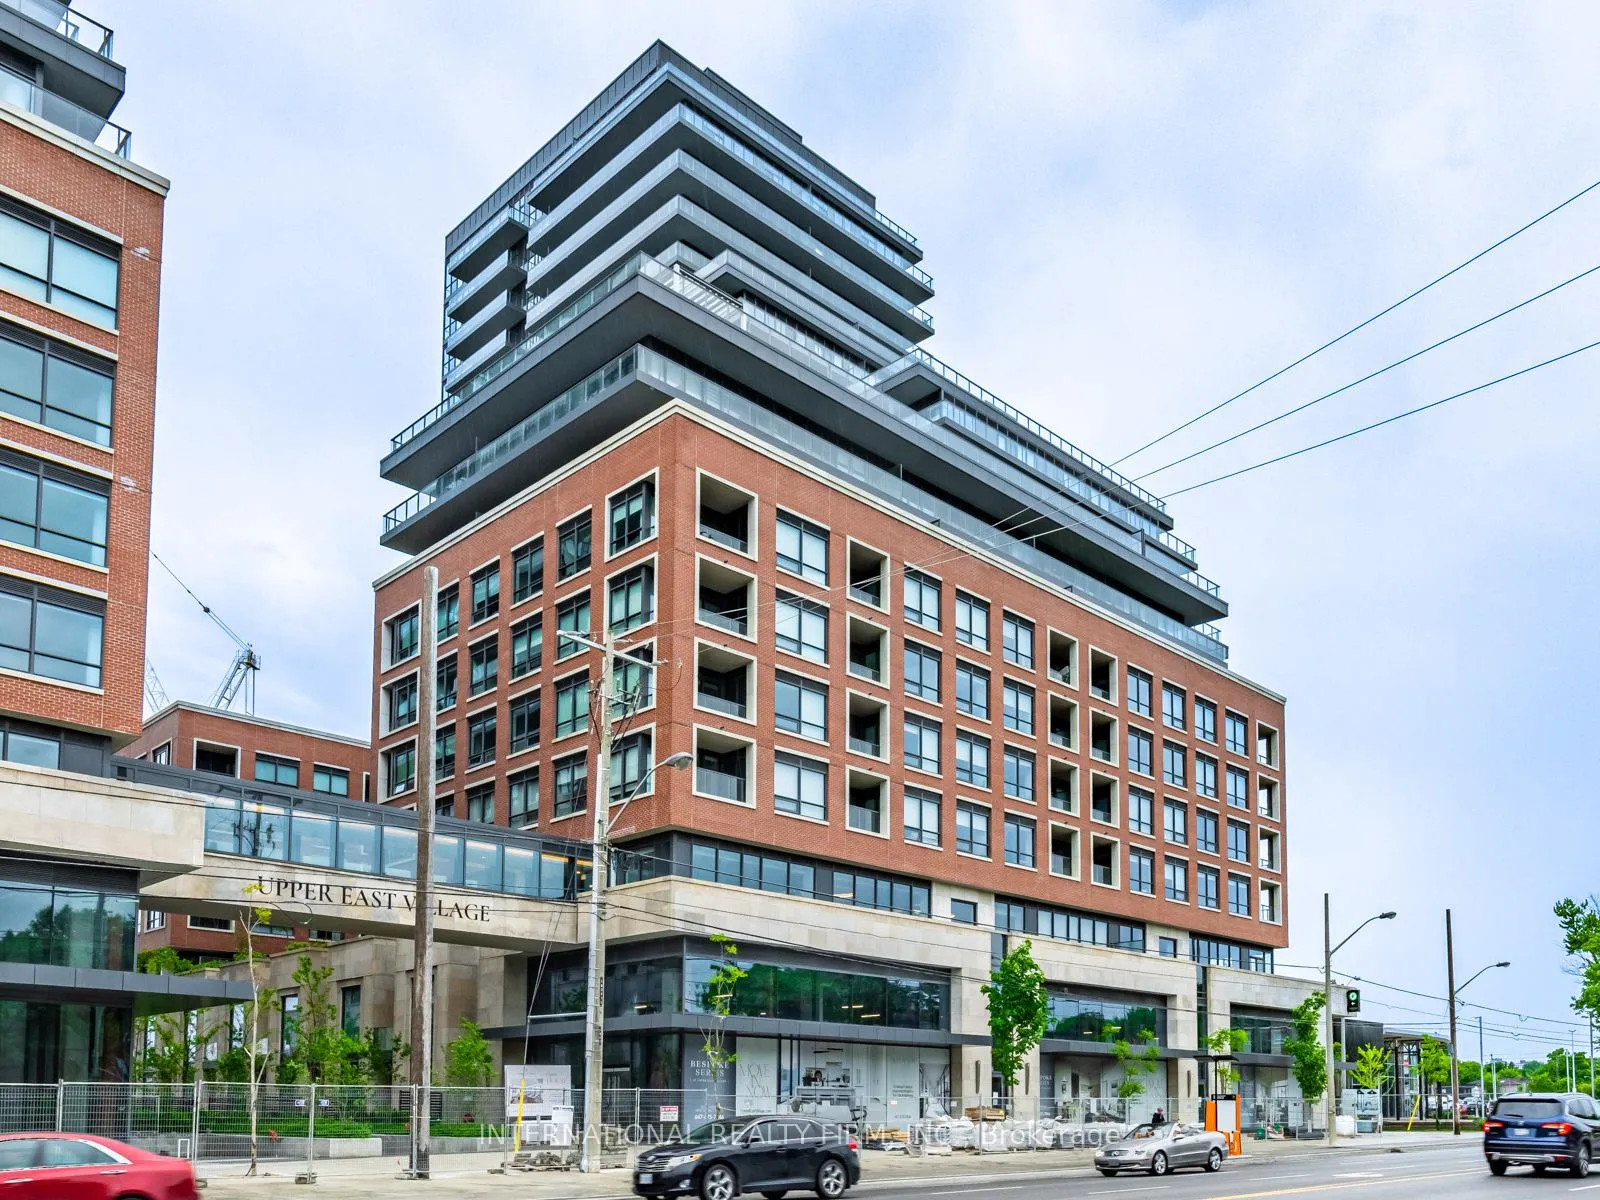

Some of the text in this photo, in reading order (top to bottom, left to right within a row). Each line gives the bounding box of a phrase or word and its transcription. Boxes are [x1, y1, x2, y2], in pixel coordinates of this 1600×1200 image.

[258, 876, 491, 922] UPPER EAST VLAGE
[690, 1060, 729, 1069] BESKE
[695, 1069, 725, 1077] SERS
